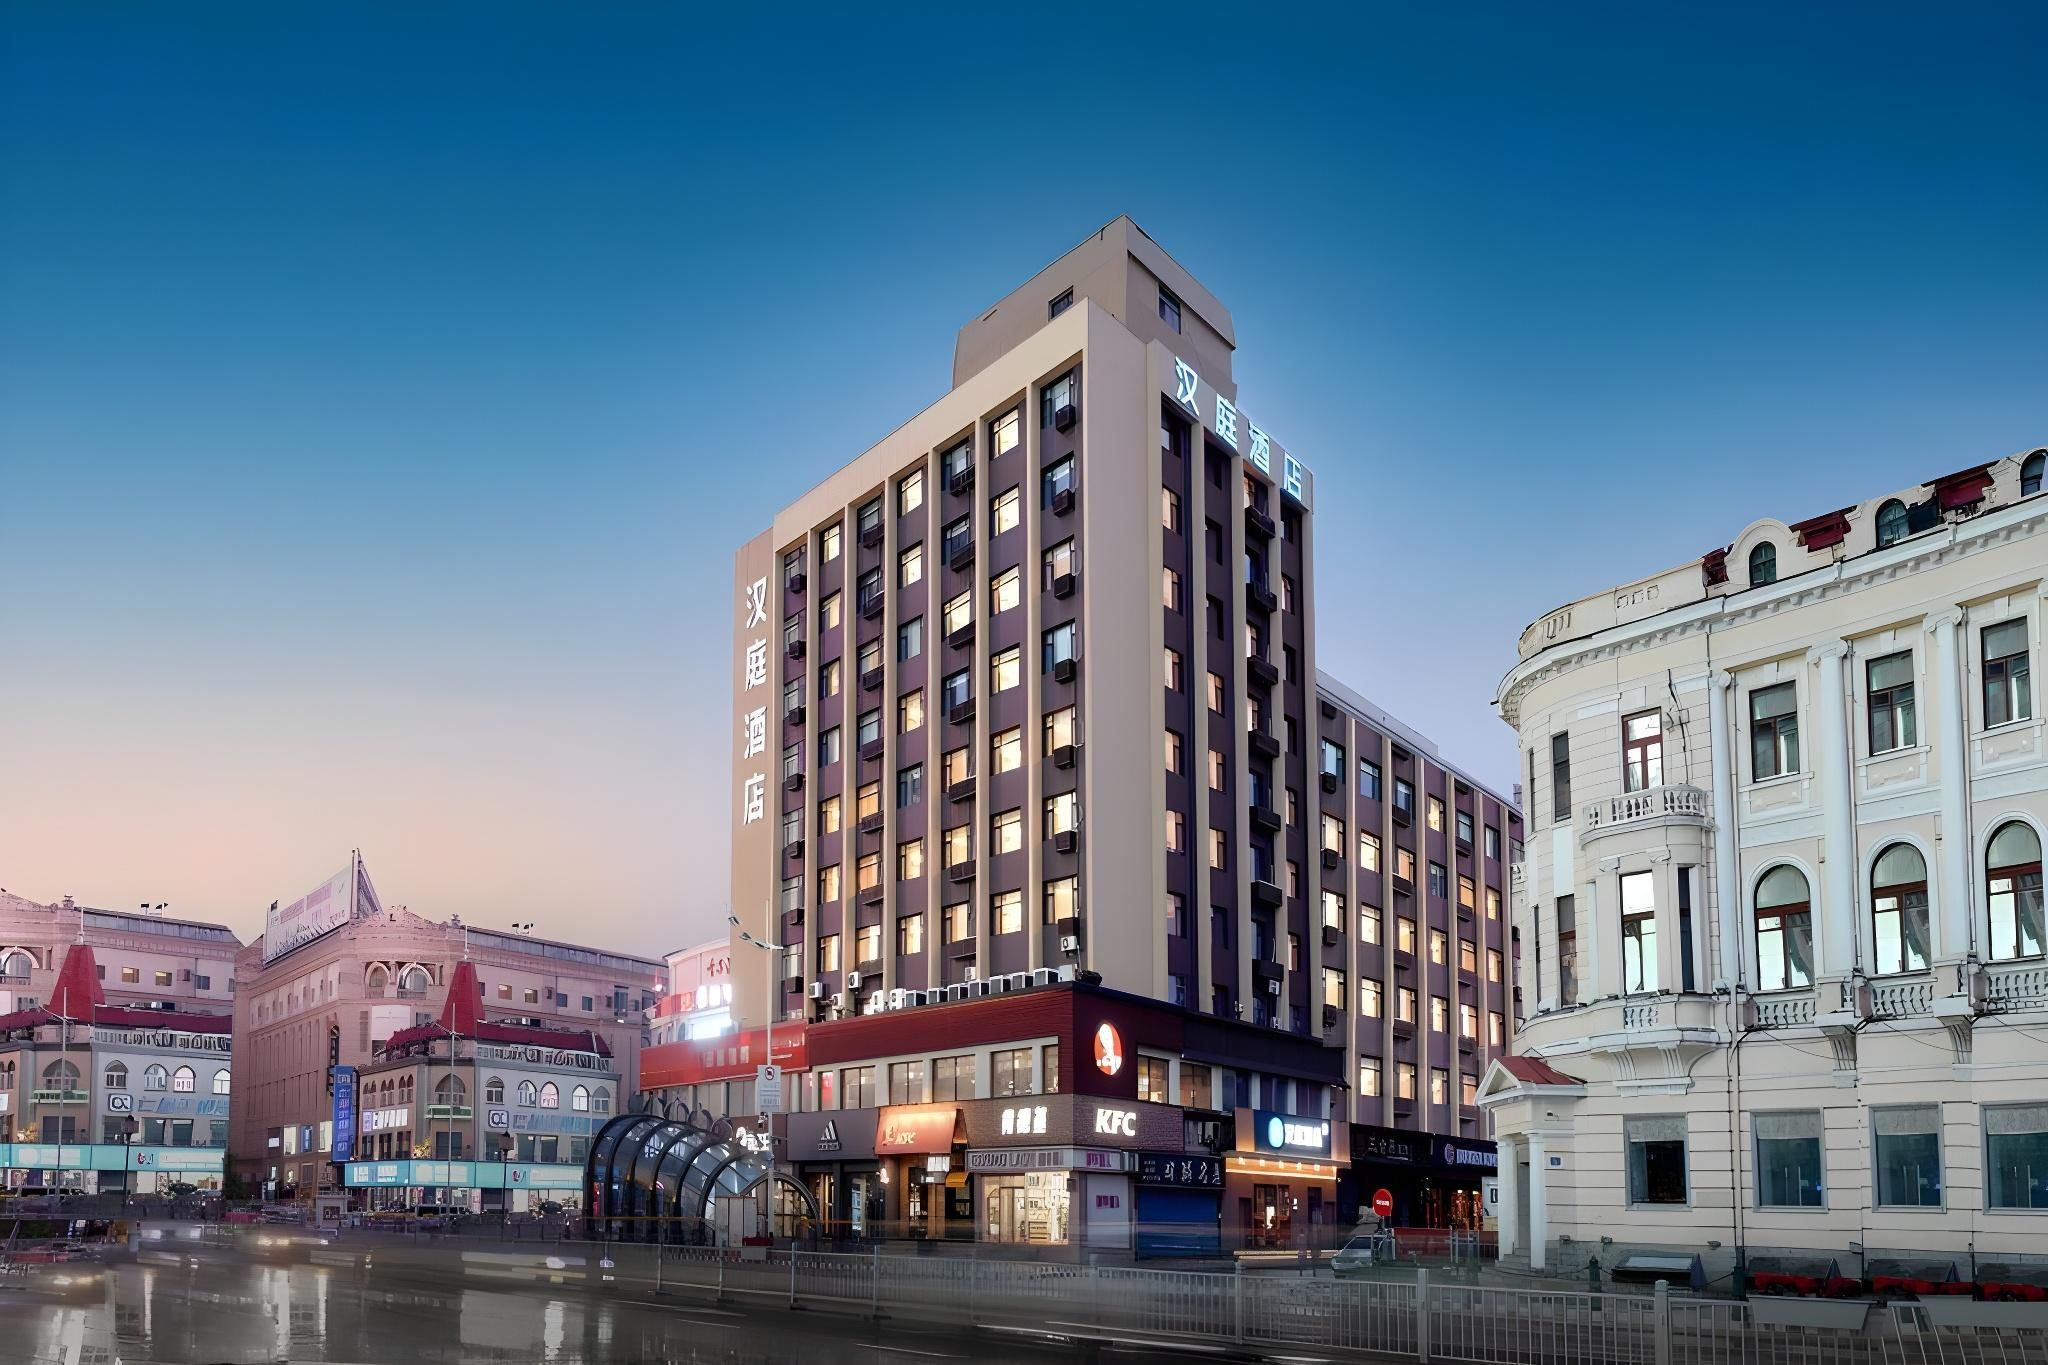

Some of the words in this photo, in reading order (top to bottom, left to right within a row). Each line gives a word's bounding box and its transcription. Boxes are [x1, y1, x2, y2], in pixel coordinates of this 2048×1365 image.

[1175, 356, 1302, 501] 汉庭酒店
[744, 576, 767, 824] 汉庭酒店
[1096, 1108, 1136, 1136] KFC
